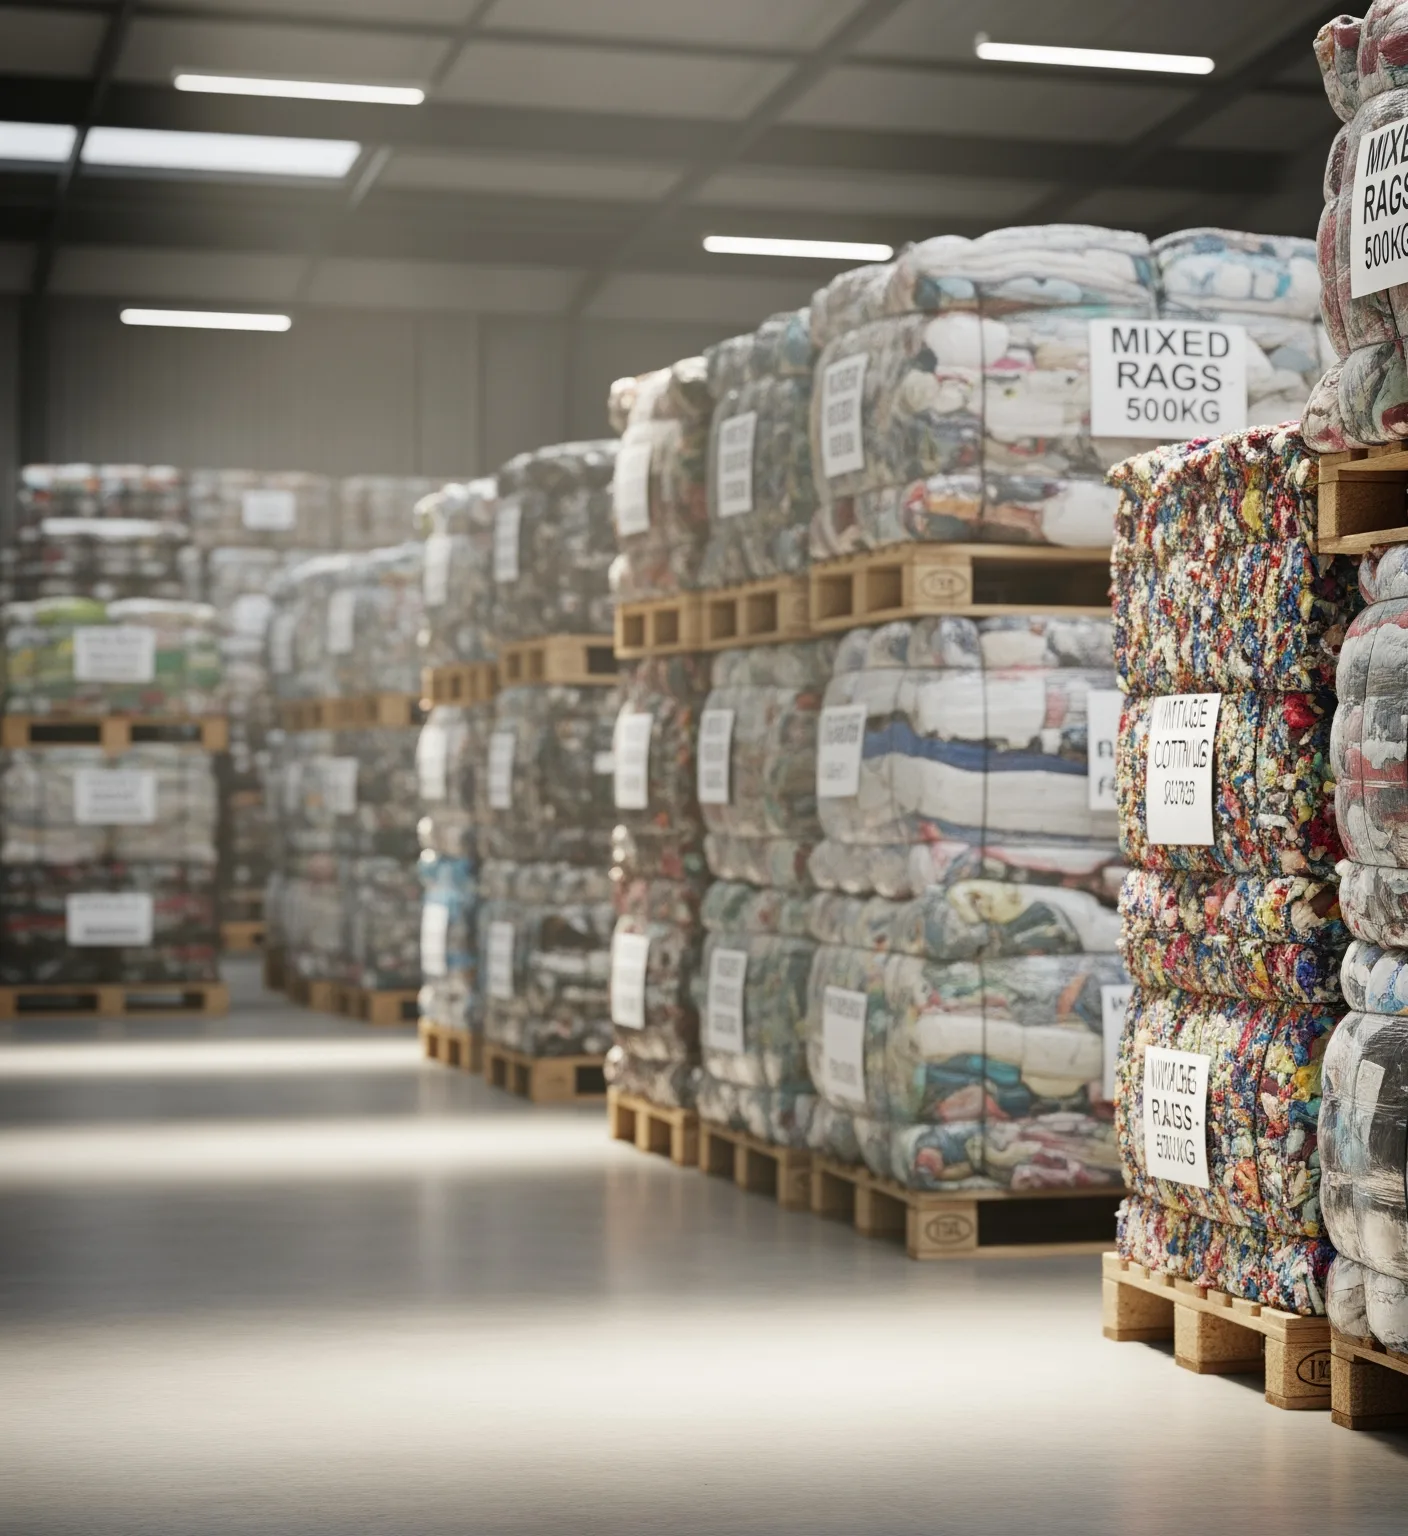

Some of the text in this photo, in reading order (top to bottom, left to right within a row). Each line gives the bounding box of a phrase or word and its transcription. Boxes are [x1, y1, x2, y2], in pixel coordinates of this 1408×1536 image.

[1111, 326, 1230, 358] MIXED
[1117, 361, 1222, 393] RAGS
[1125, 397, 1220, 425] 500KG
